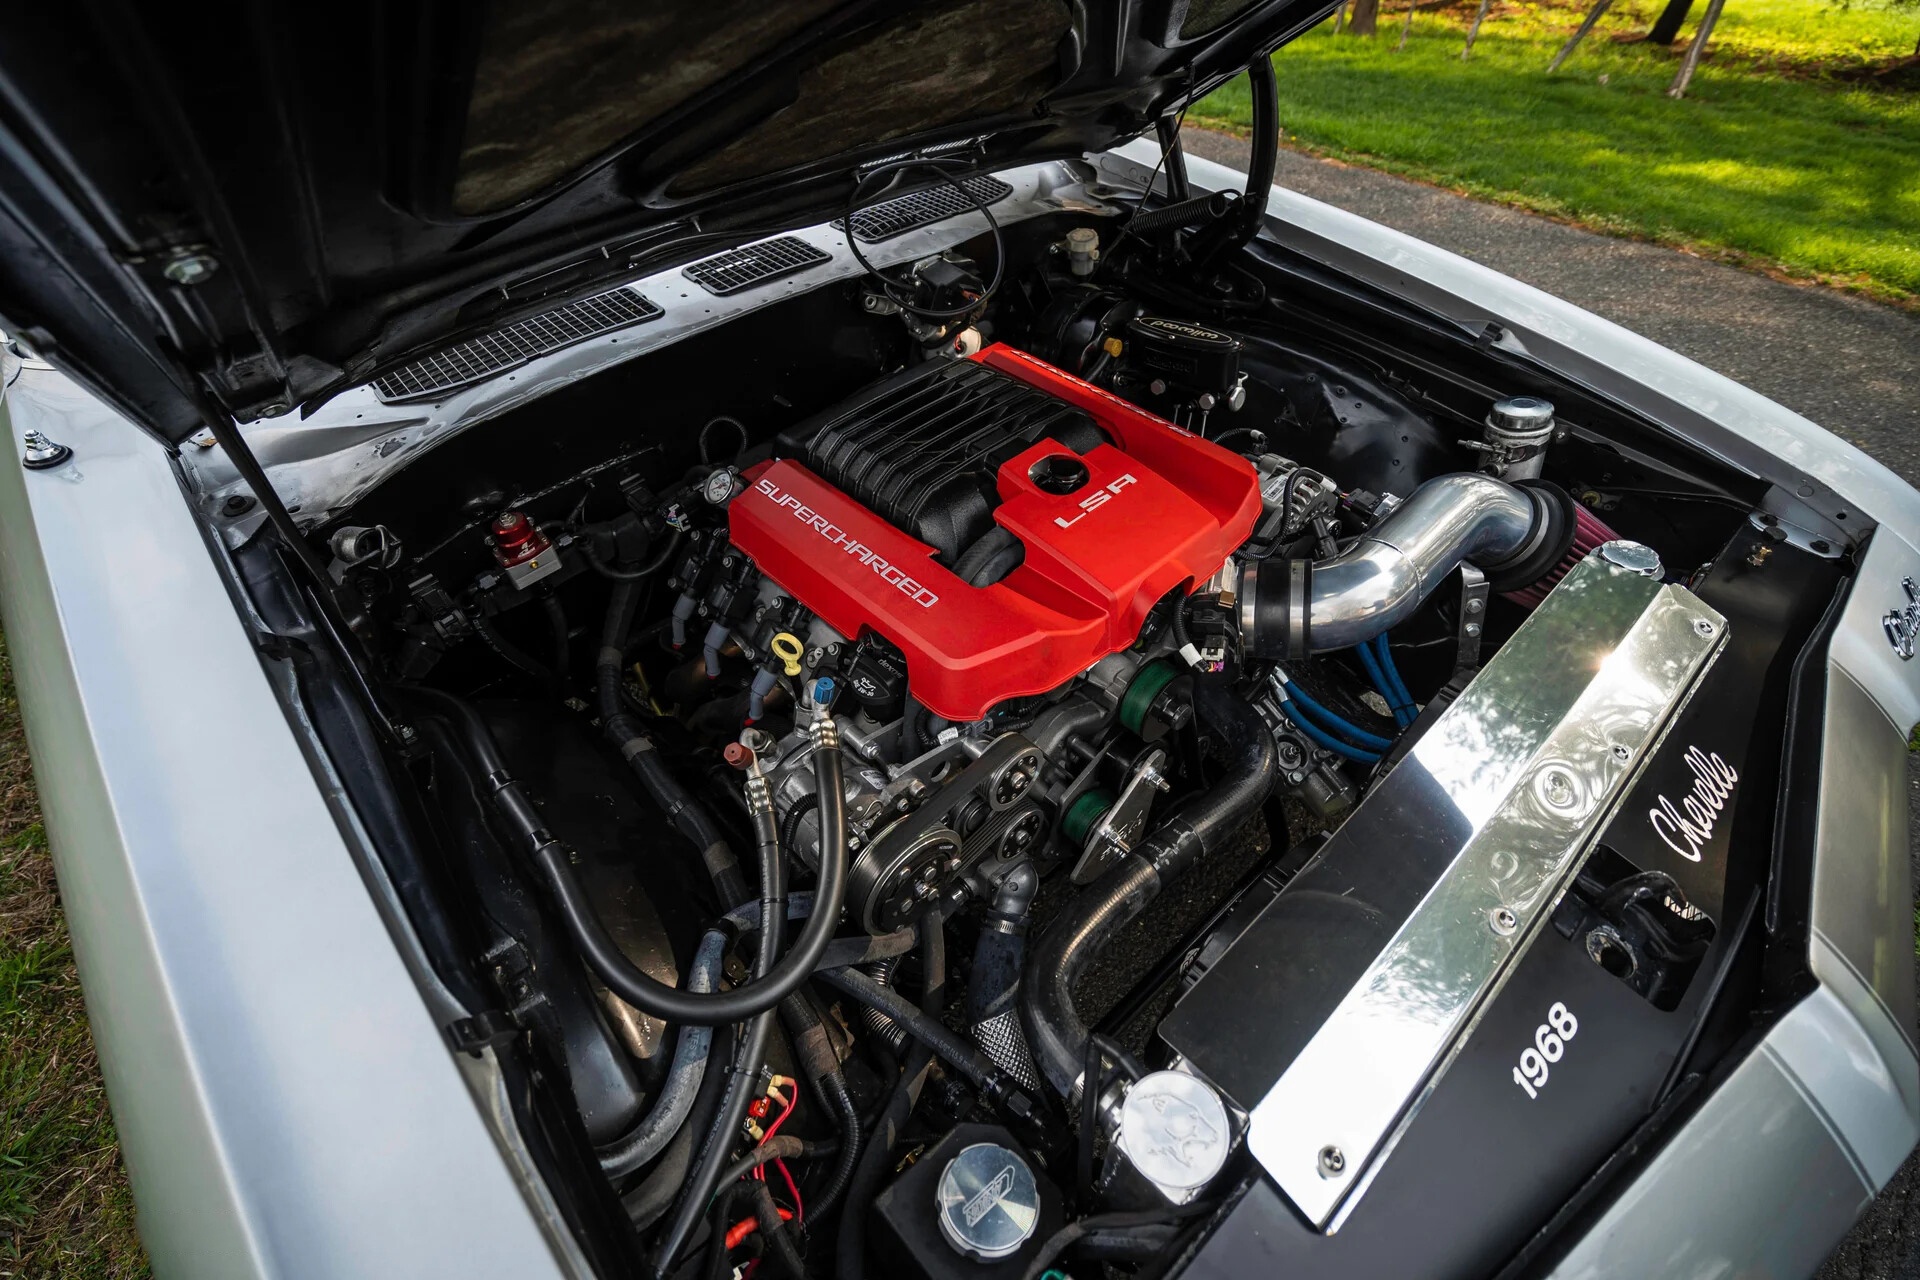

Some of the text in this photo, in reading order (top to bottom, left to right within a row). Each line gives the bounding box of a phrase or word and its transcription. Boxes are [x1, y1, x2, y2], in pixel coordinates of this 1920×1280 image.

[1150, 320, 1219, 340] wilwood
[754, 478, 940, 608] SUPERCHARGED
[1053, 473, 1138, 529] LSA
[1649, 744, 1739, 862] Chevelle
[1512, 1001, 1579, 1100] 1968
